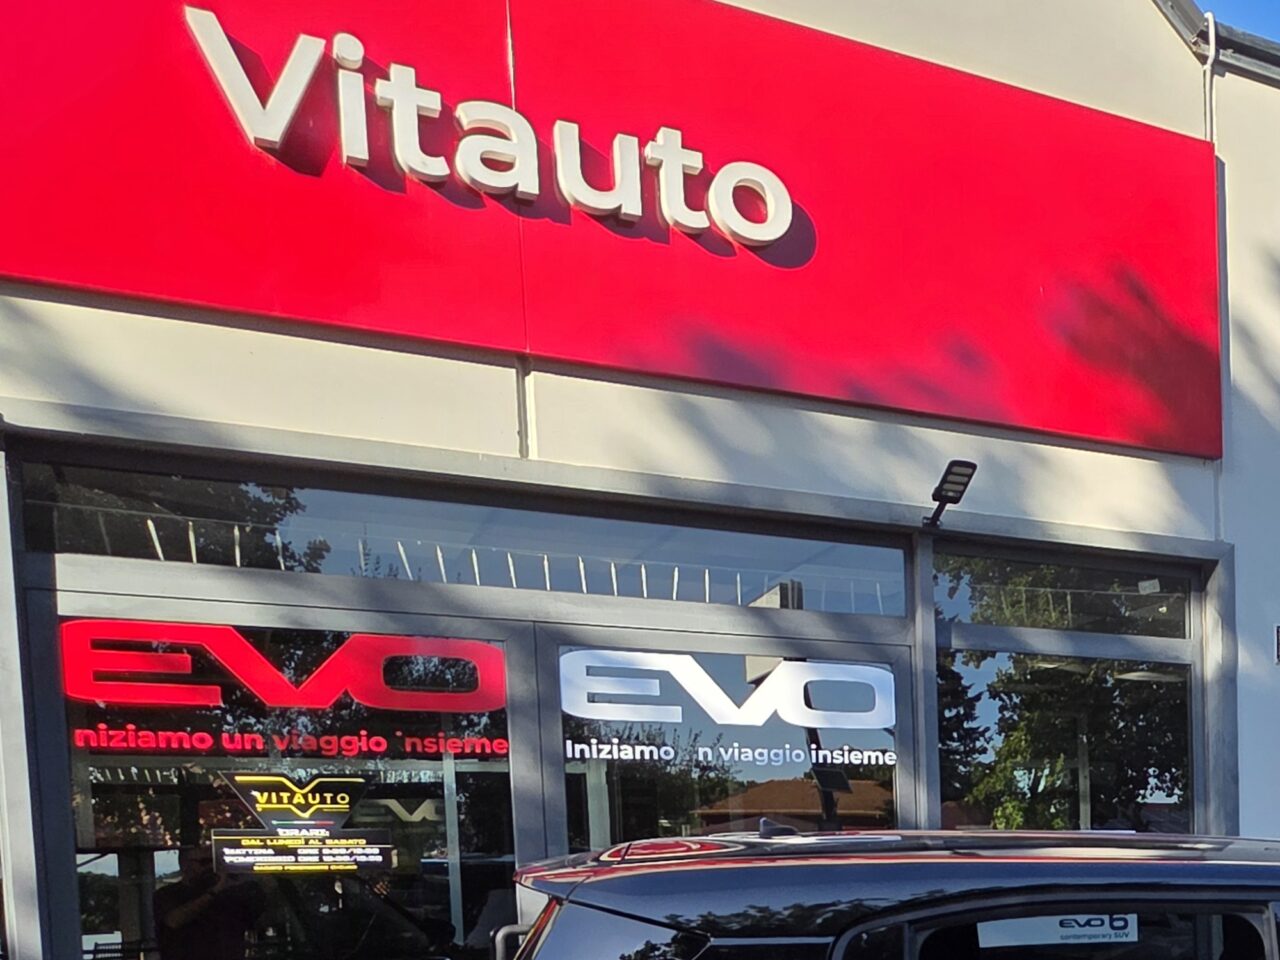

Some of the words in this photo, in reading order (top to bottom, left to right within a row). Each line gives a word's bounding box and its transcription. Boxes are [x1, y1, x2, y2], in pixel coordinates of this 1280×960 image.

[184, 4, 793, 247] Vitauto
[60, 618, 507, 713] EVO
[559, 649, 896, 729] EVO
[73, 723, 214, 750] niziamo
[221, 732, 264, 752] un
[271, 729, 388, 757] viaggio
[565, 738, 676, 761] Iniziamo
[718, 743, 806, 767] viaggio
[810, 744, 898, 766] insieme
[255, 791, 350, 805] VITAUTO
[1058, 917, 1106, 929] EVO
